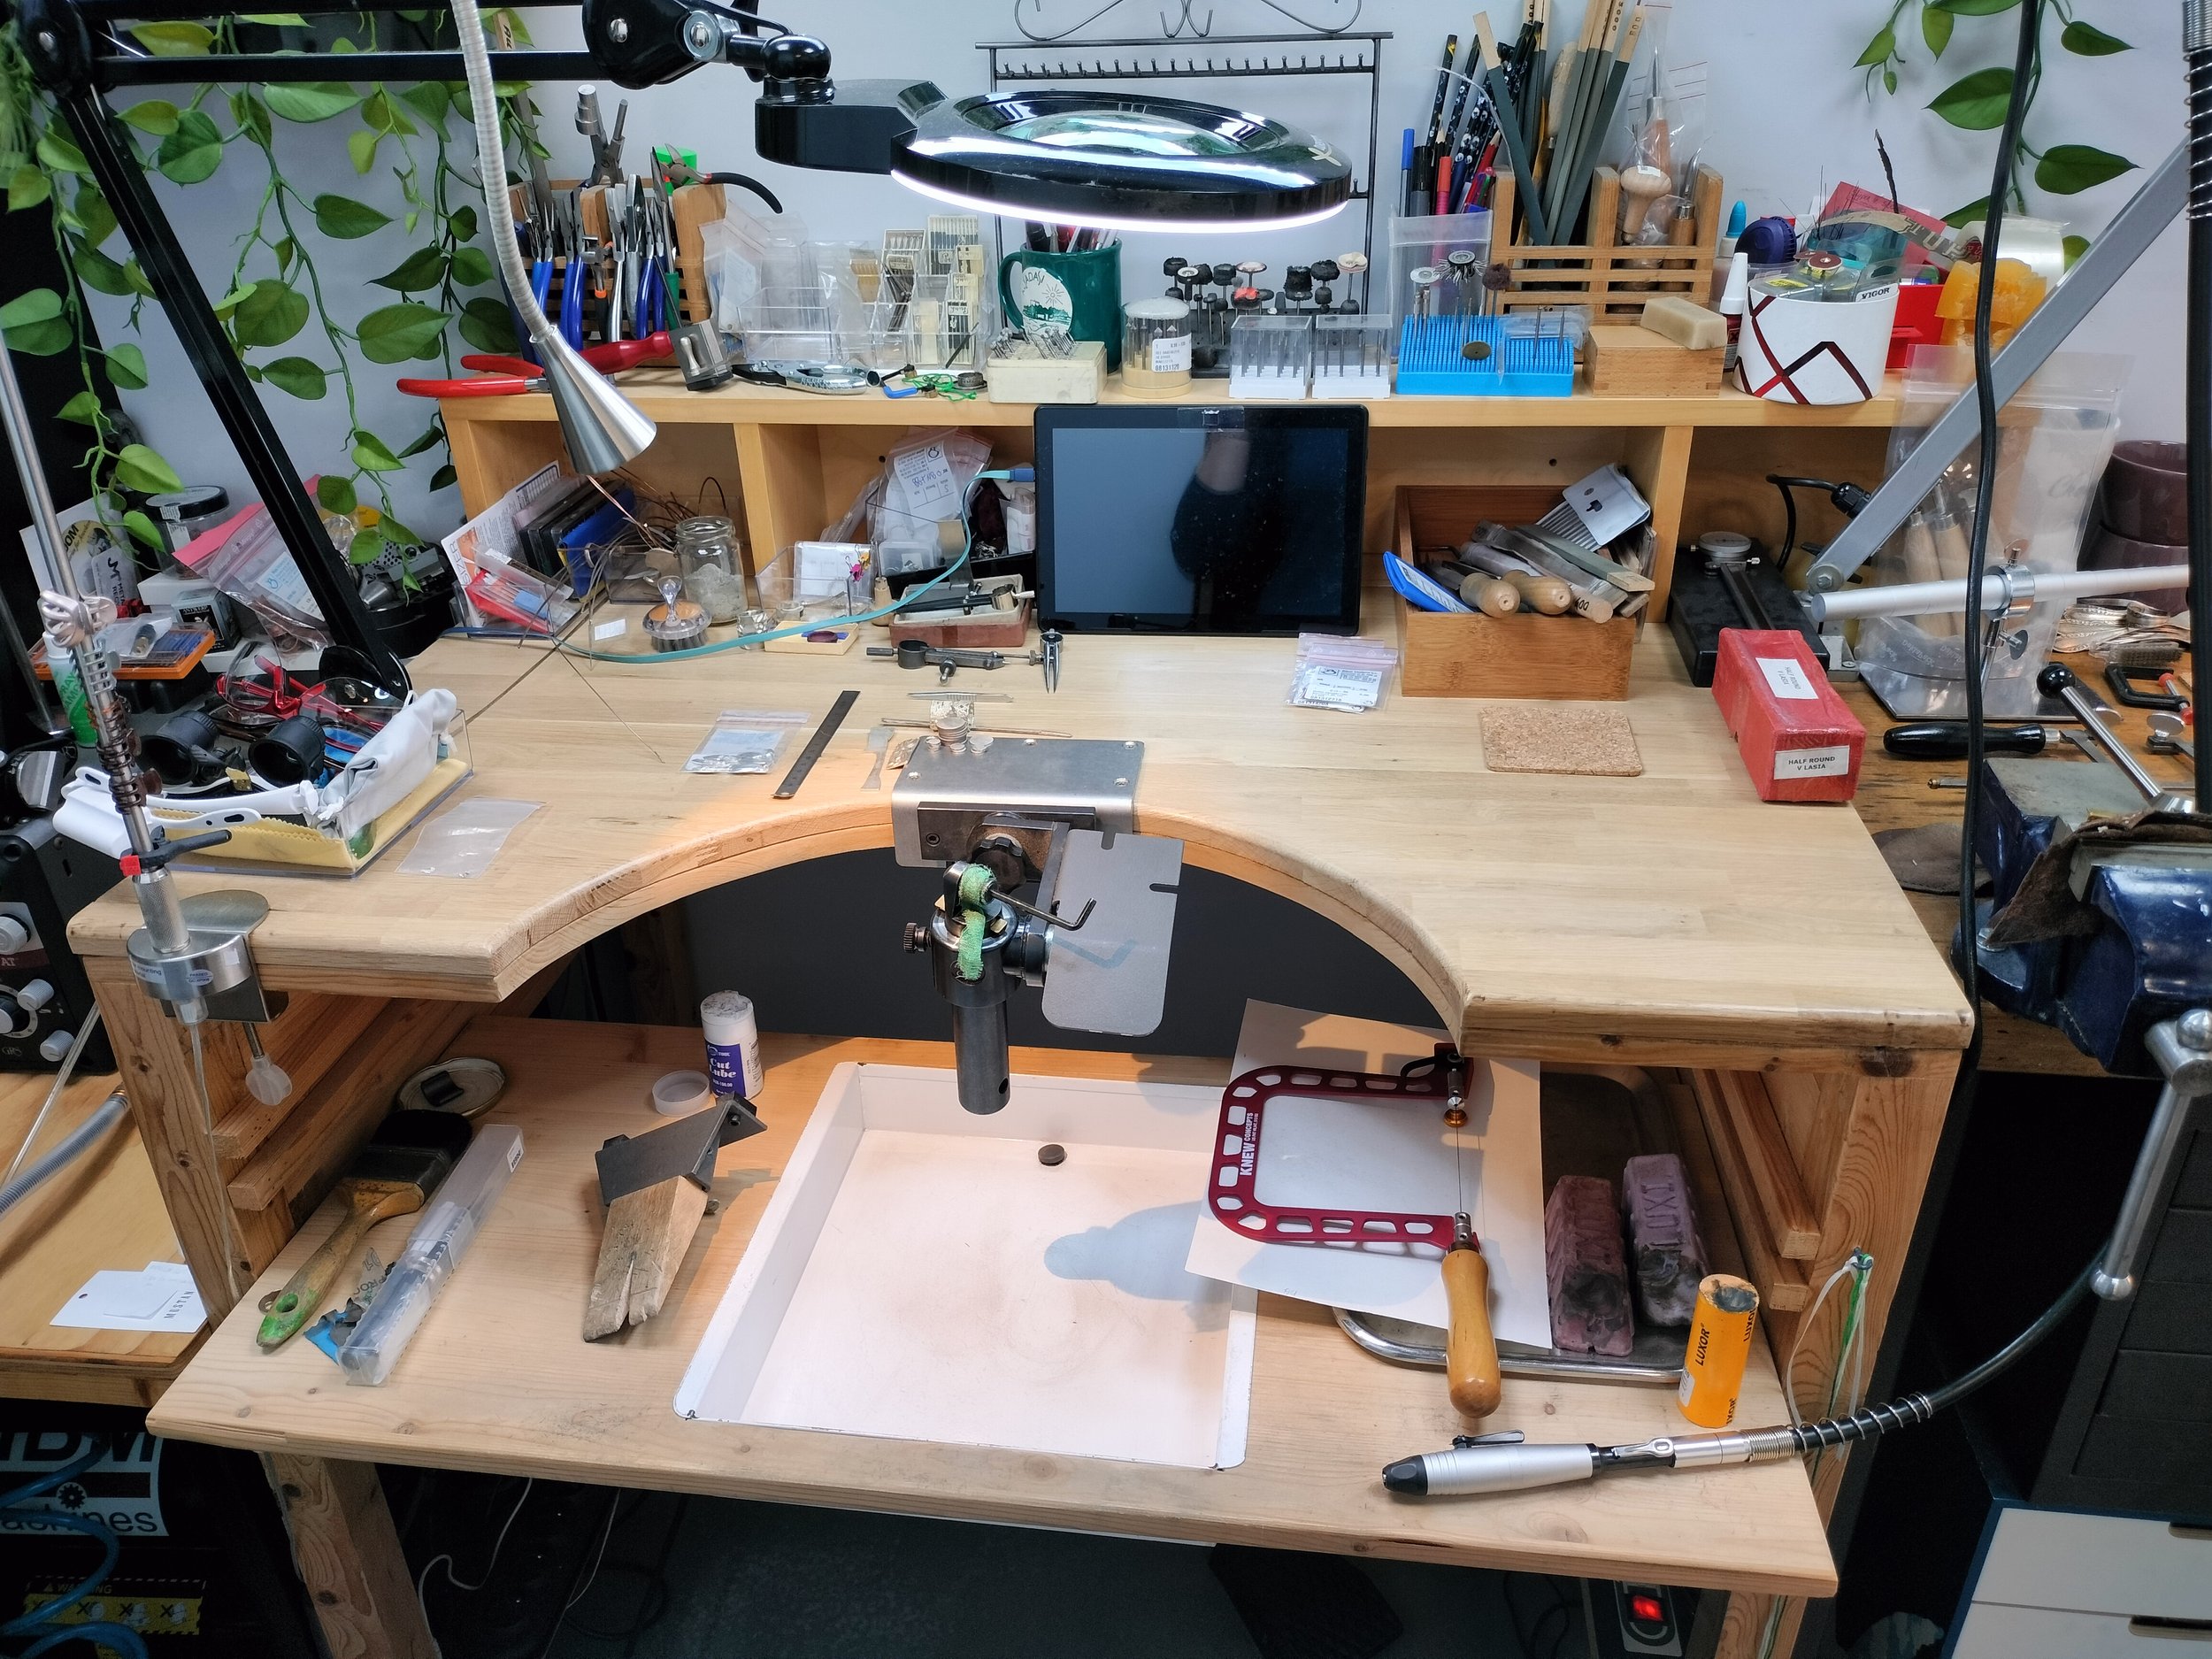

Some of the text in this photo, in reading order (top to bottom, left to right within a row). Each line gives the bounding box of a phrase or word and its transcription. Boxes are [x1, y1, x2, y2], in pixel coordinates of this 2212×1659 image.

[1861, 287, 1890, 300] VIGOR
[709, 1064, 737, 1079] Lube
[710, 1057, 731, 1070] Cut
[1243, 1112, 1254, 1142] CONCEPTS
[1240, 1142, 1256, 1176] KNEW
[1695, 1327, 1711, 1367] LUXOR
